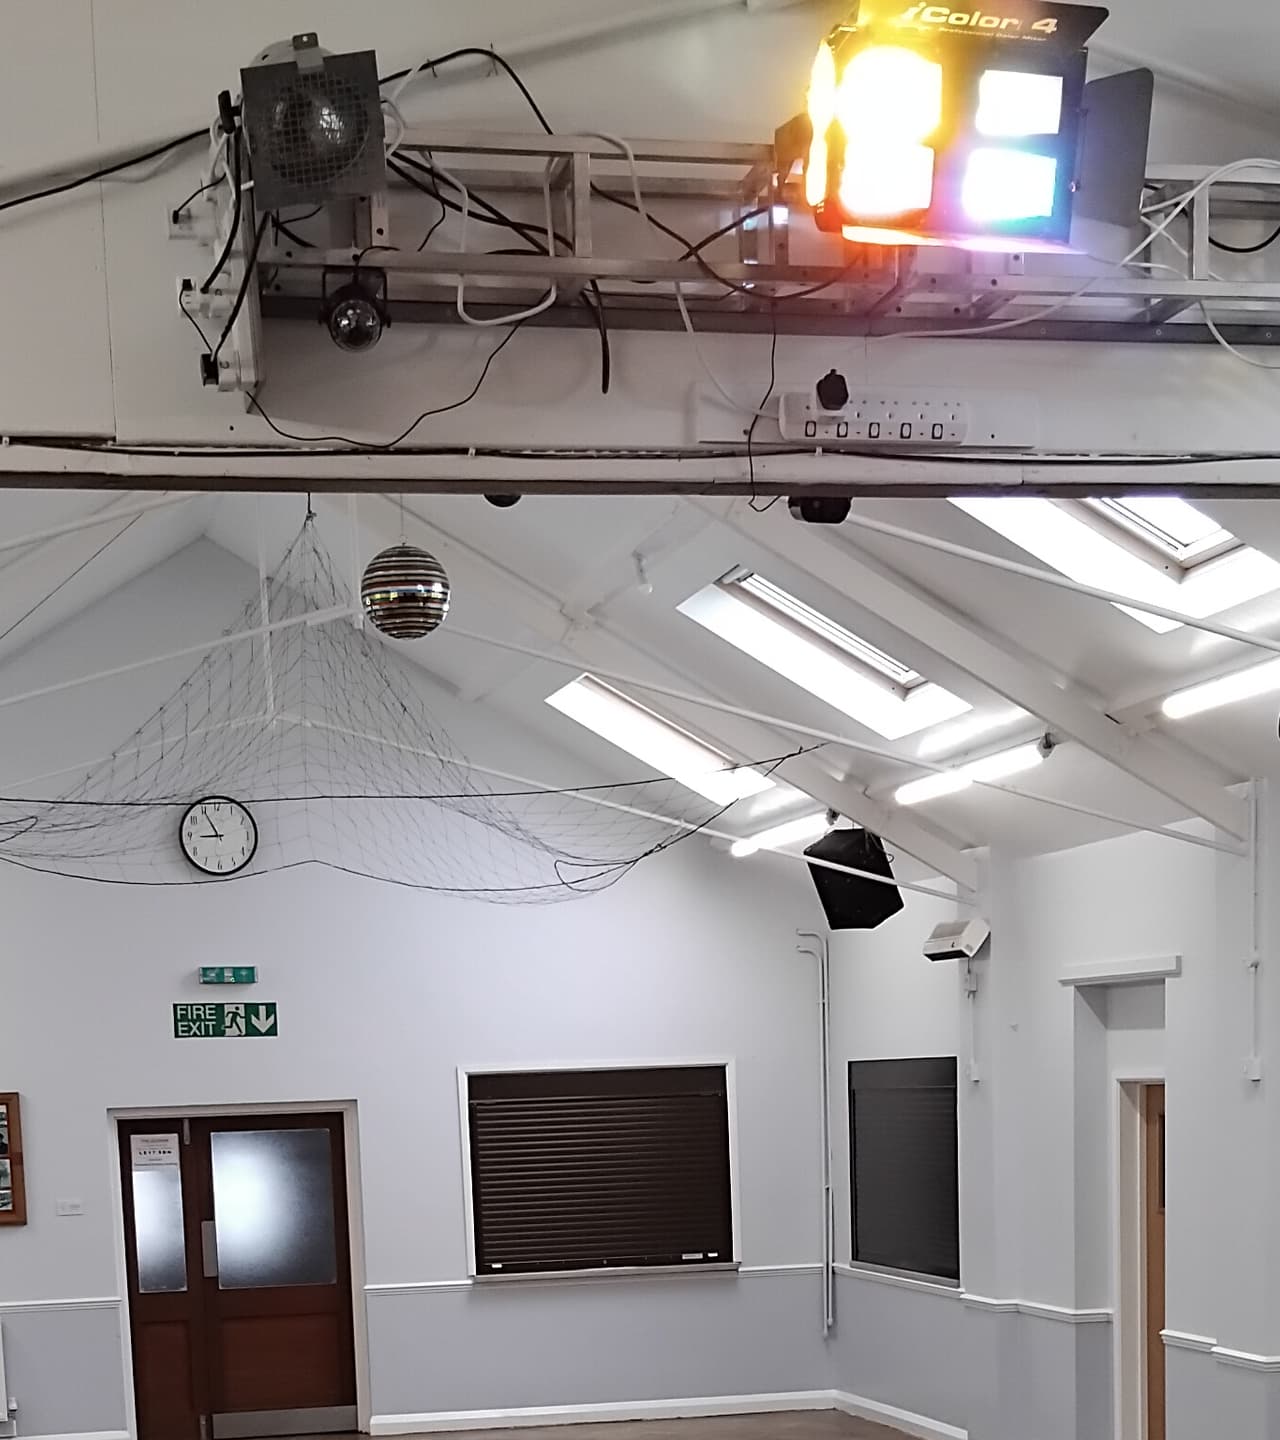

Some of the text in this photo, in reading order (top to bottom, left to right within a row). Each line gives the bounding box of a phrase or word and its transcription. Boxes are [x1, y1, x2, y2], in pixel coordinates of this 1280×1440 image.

[1031, 17, 1058, 34] 4
[187, 831, 193, 840] 9
[177, 1004, 217, 1020] FIRE
[178, 1021, 217, 1036] EXIT
